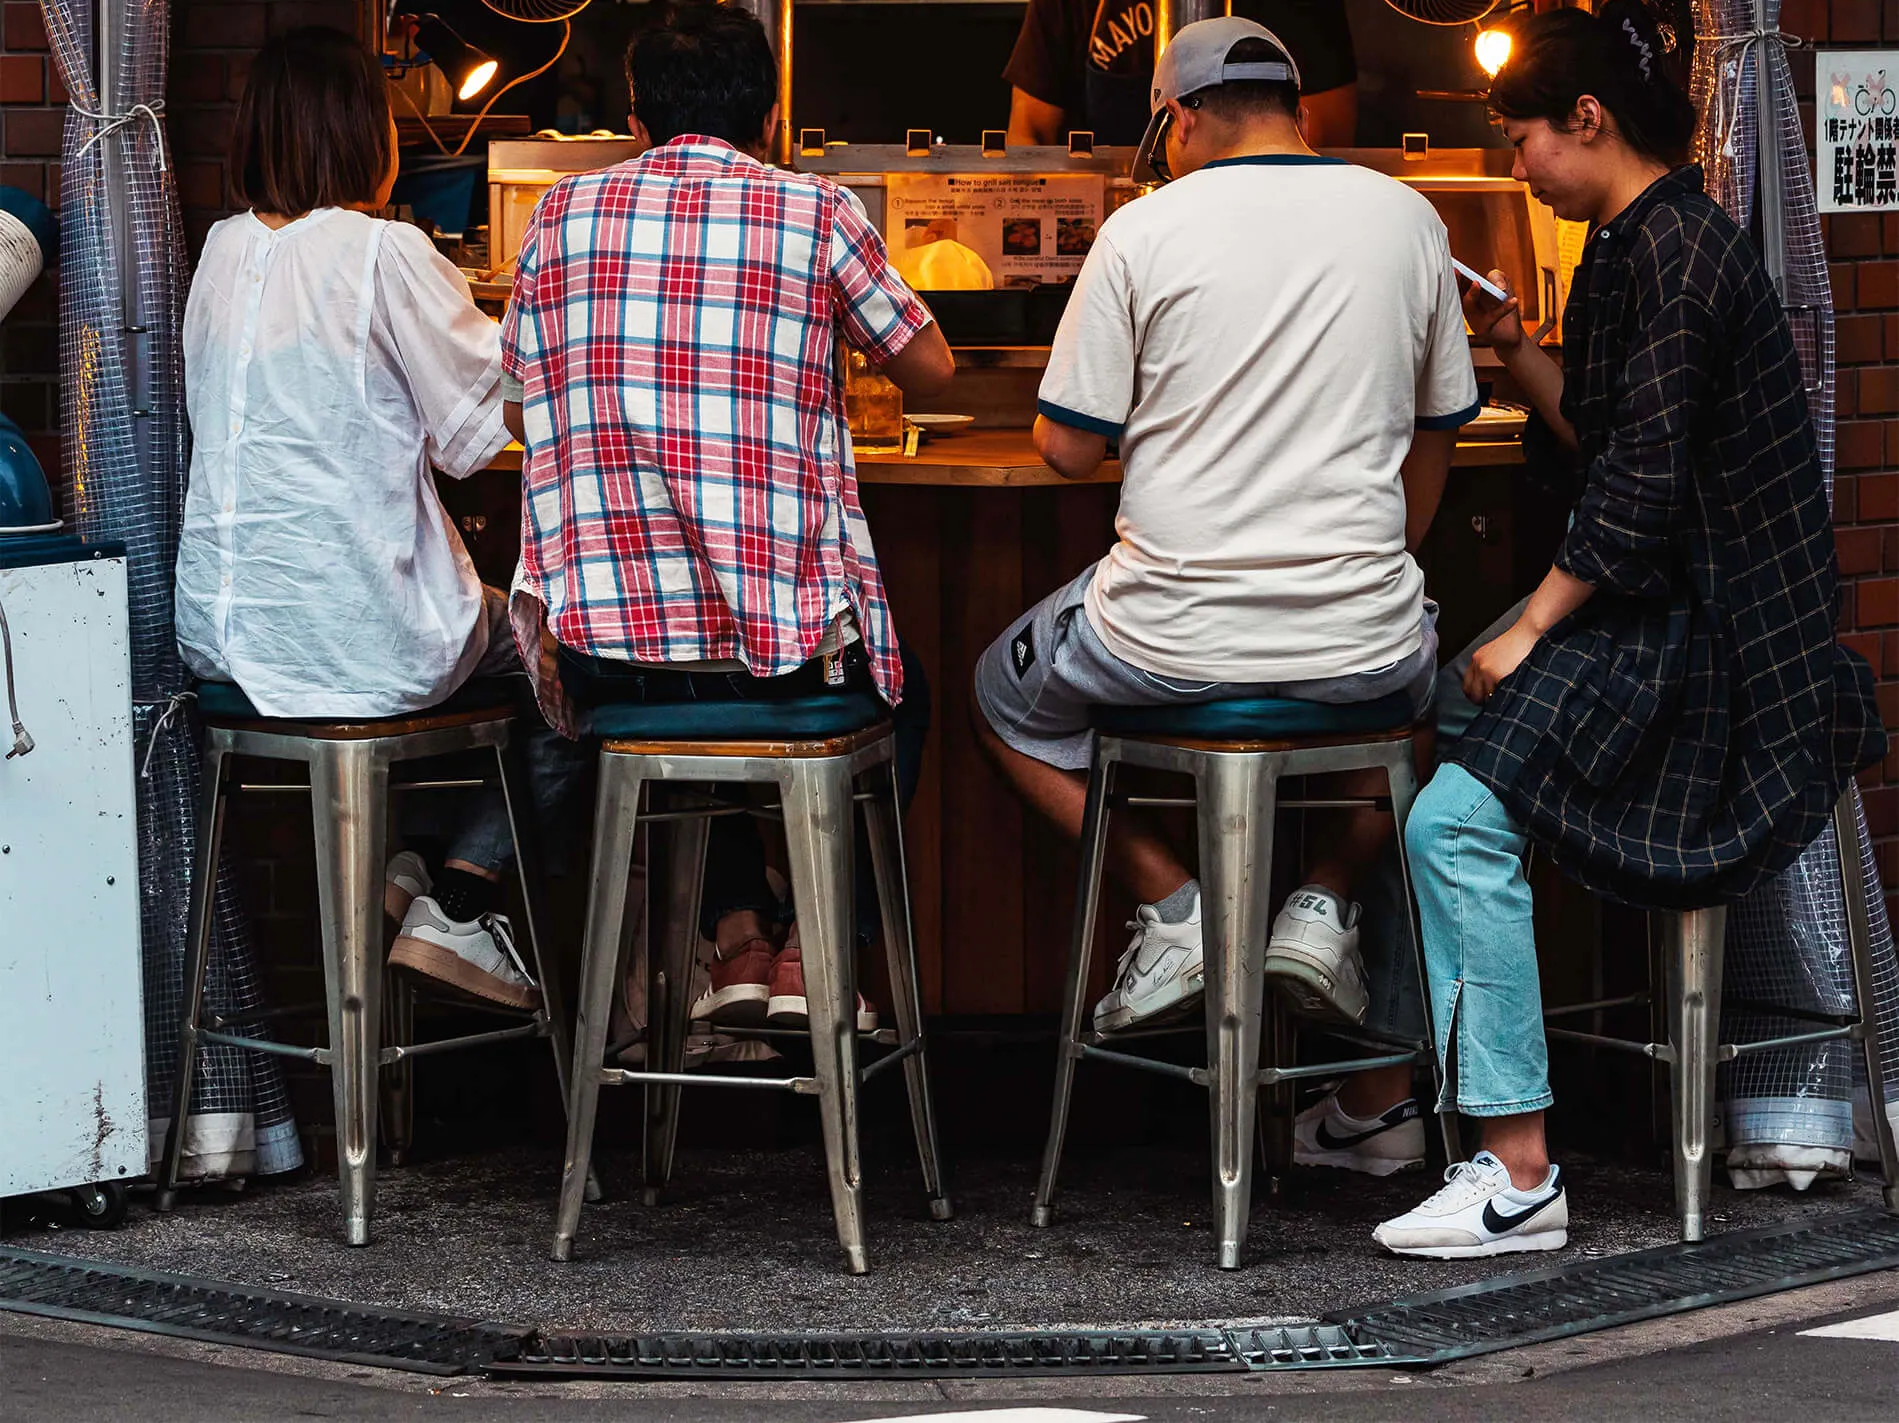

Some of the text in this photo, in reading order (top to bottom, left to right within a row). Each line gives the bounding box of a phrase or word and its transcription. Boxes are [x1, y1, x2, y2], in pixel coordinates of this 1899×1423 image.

[1092, 2, 1153, 71] MAYO
[1833, 143, 1899, 206] 駐輪禁
